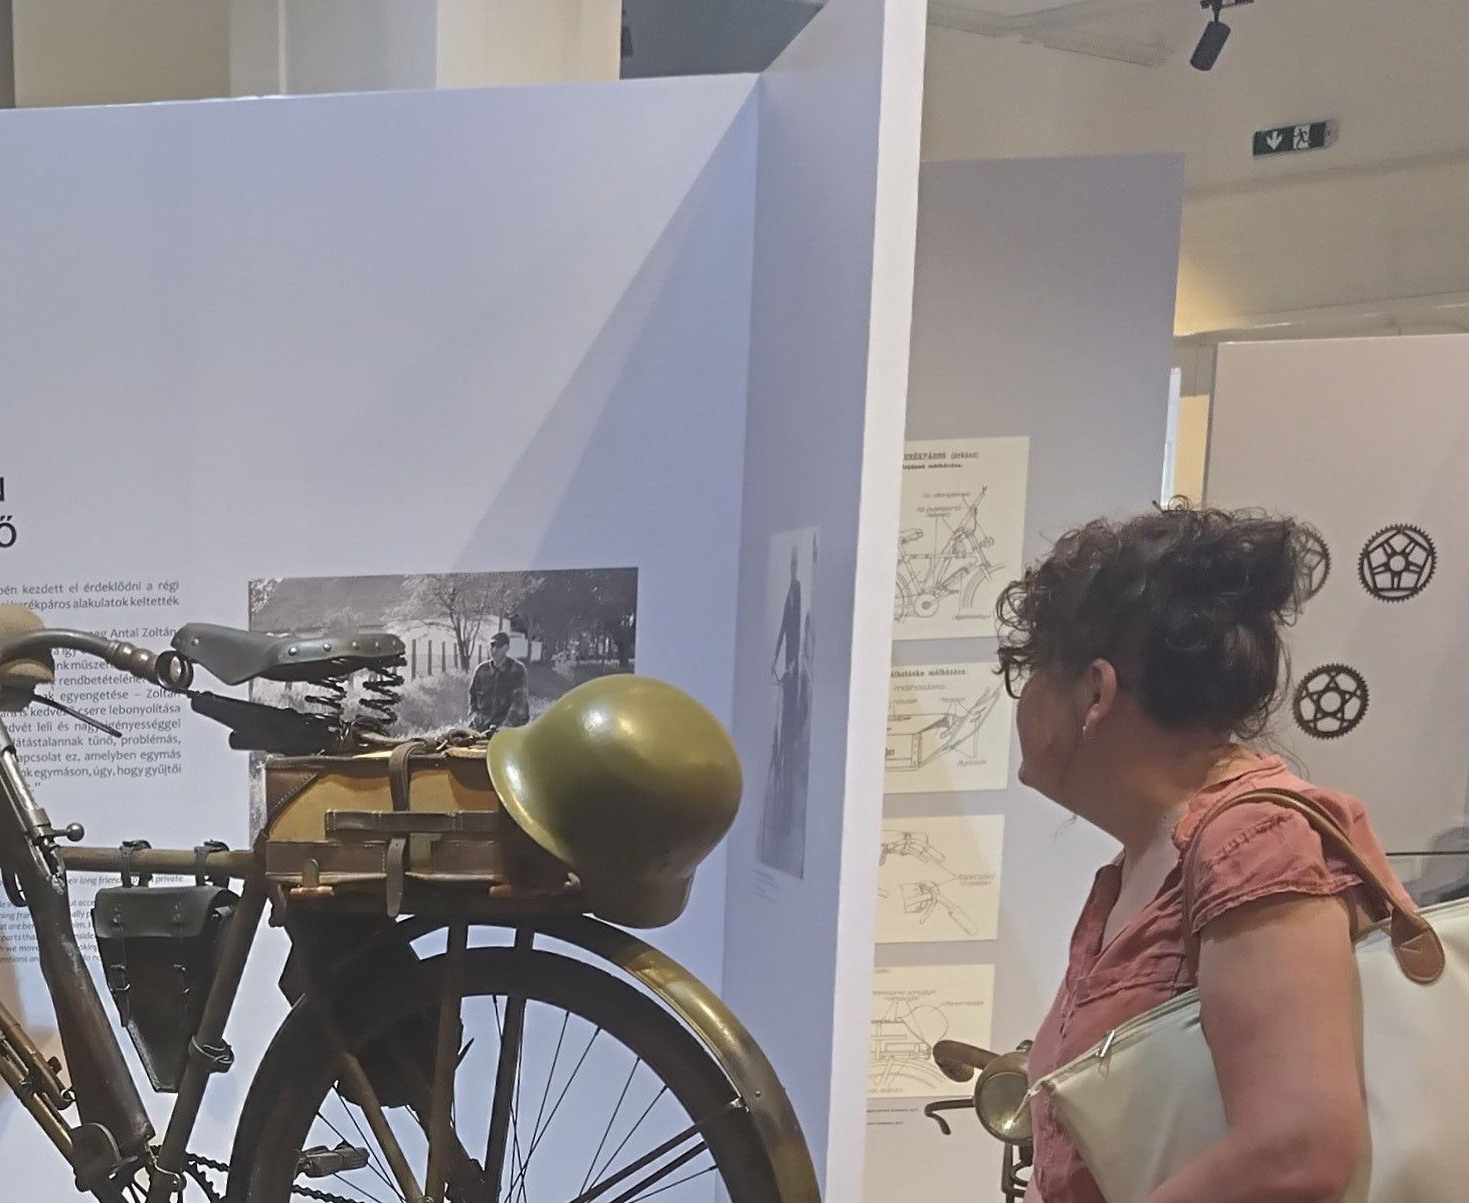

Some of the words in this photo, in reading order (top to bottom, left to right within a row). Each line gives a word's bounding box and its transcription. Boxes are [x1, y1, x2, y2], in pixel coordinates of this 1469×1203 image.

[22, 583, 63, 594] kezdett
[69, 582, 78, 593] el
[84, 580, 141, 593] érdeklődni
[147, 583, 153, 592] a
[158, 580, 179, 592] régi
[73, 597, 128, 609] alakulatok
[130, 595, 179, 607] keltették
[110, 628, 138, 639] Antal
[60, 689, 129, 703] egyengetése
[109, 703, 181, 718] lebonyolítása
[37, 721, 52, 732] leli
[57, 721, 69, 732] és
[121, 734, 181, 749] problémás,
[18, 753, 62, 766] apcsolat
[65, 753, 81, 763] ez,
[84, 751, 137, 764] amelyben
[140, 750, 181, 763] egymás
[34, 768, 92, 780] egymáson,
[93, 765, 116, 779] úgy,
[117, 764, 143, 778] hogy
[144, 763, 182, 778] gyűjtői
